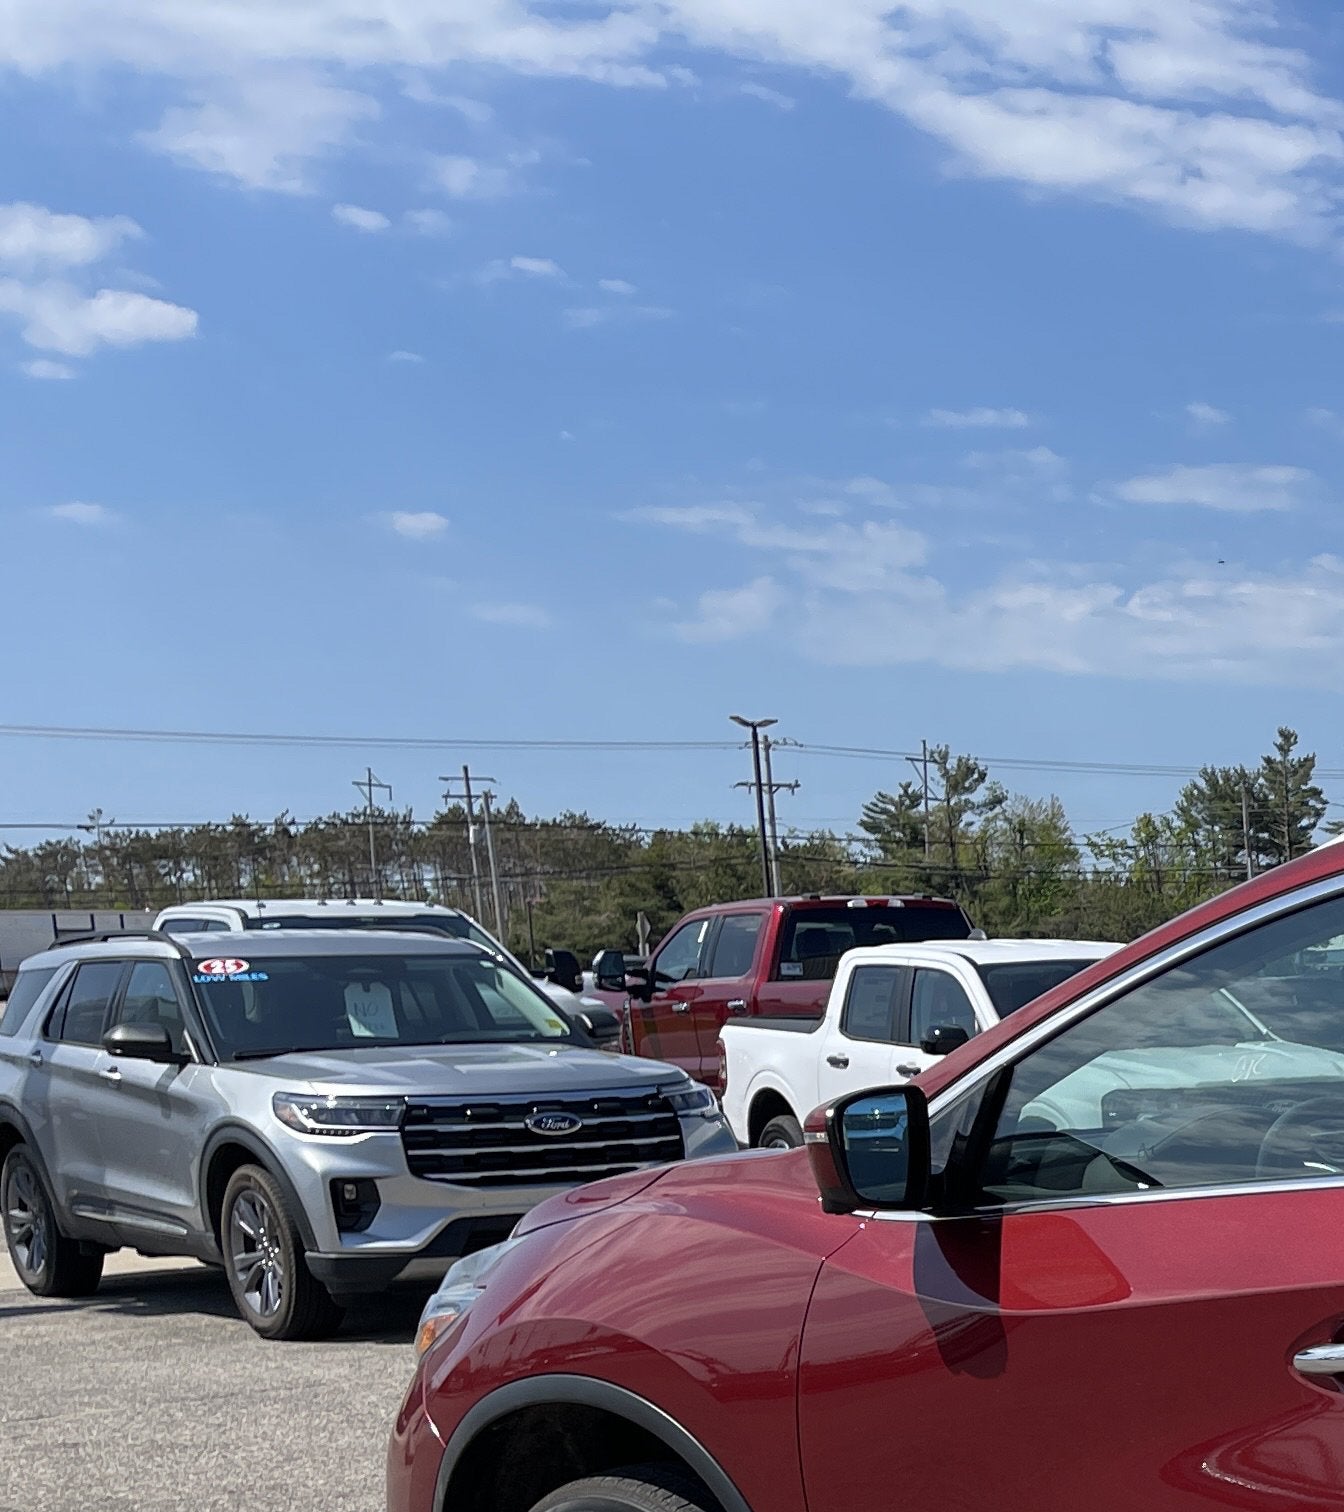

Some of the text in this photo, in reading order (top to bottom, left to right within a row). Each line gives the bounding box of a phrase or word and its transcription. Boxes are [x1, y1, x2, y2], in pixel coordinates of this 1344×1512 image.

[210, 959, 238, 974] 25
[192, 972, 269, 984] LOW MILES
[540, 1117, 570, 1131] Ford
